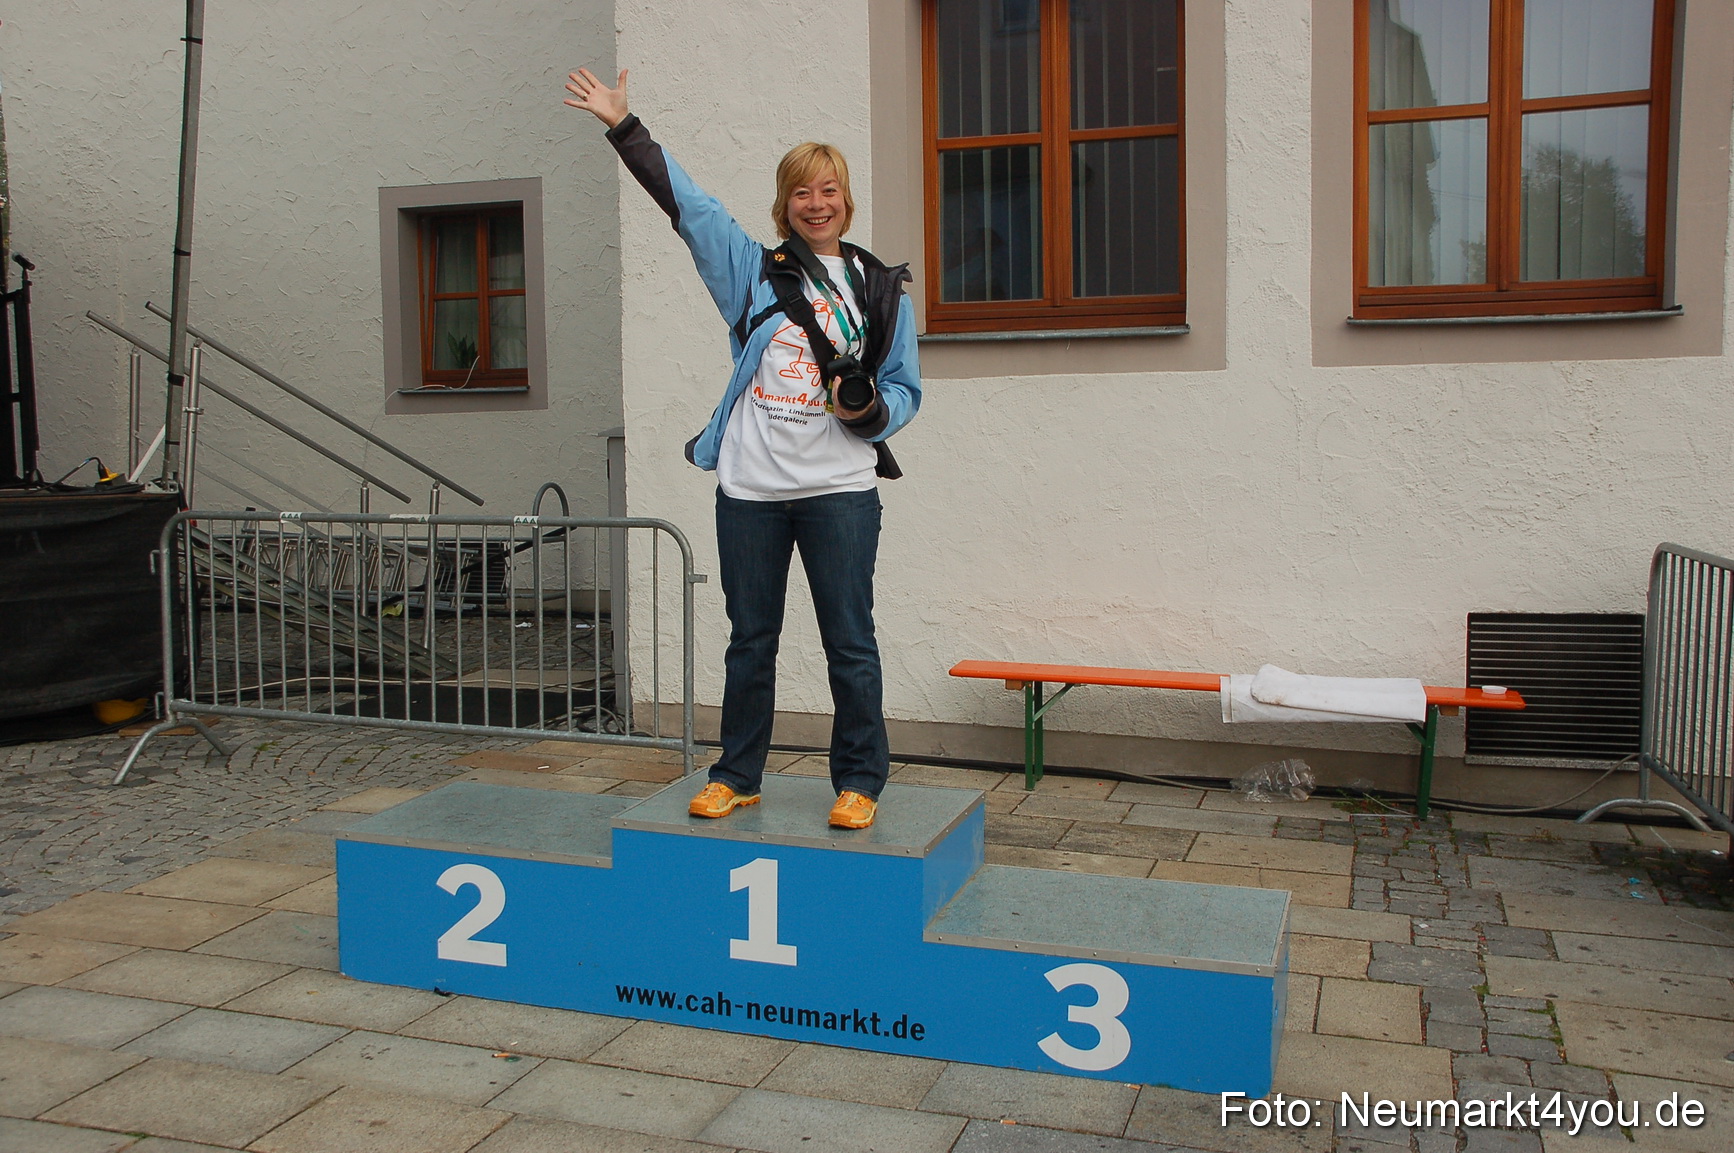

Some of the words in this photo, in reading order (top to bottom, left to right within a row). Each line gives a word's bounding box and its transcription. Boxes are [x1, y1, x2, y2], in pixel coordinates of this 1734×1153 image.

[436, 864, 507, 967] 2
[729, 858, 798, 967] 1
[615, 984, 925, 1042] www.cah-neumarkt.de
[1037, 962, 1131, 1073] 3
